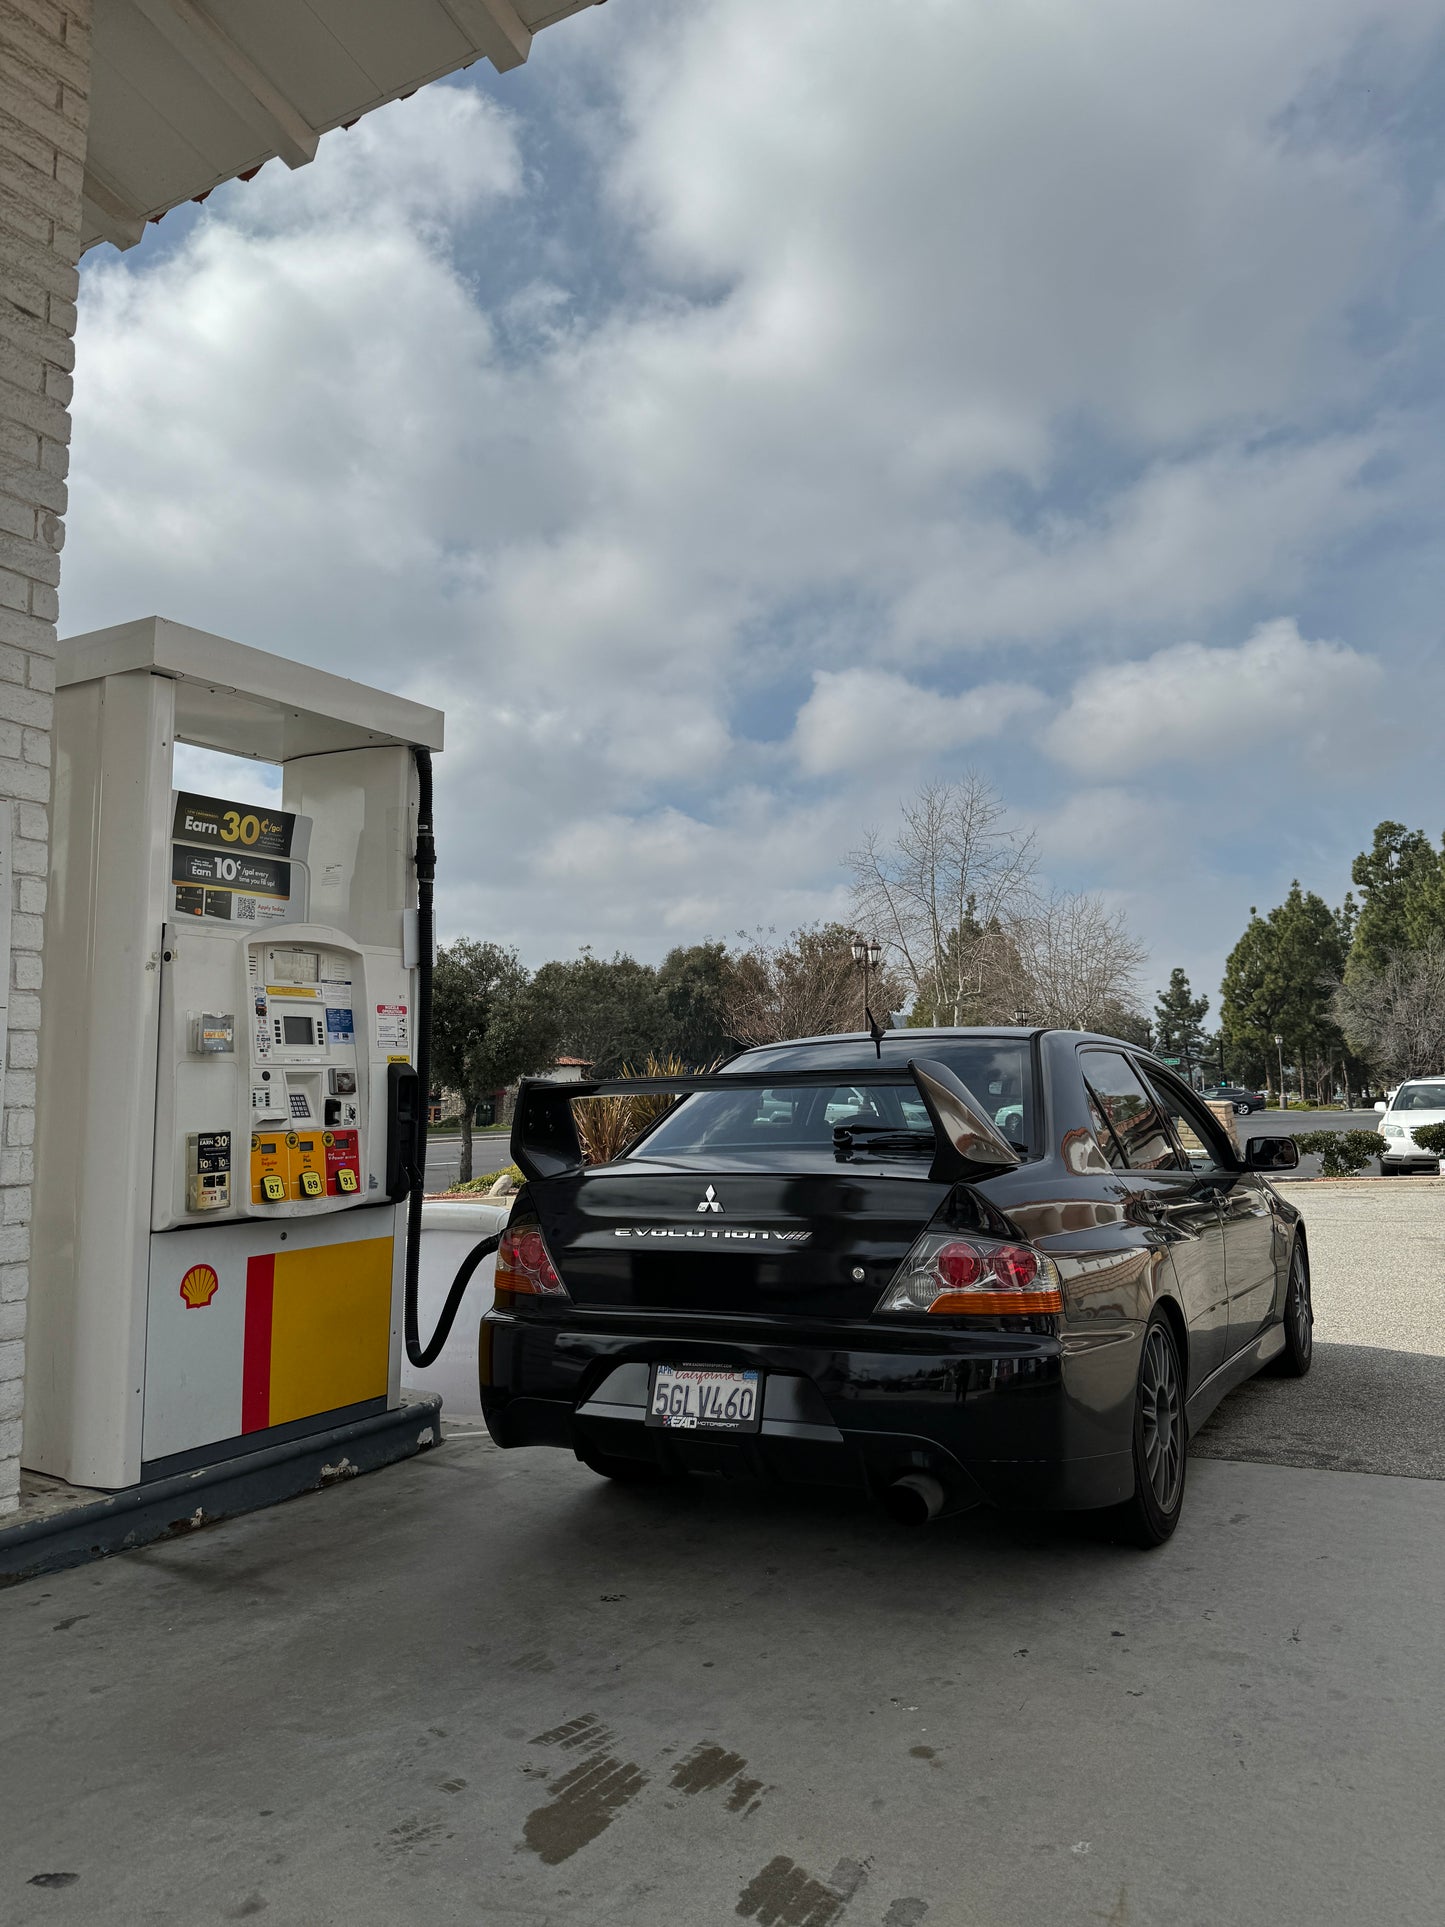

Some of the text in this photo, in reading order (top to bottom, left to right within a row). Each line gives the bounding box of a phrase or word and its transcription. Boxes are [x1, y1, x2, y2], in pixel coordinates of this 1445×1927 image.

[184, 816, 218, 835] Earn
[192, 866, 212, 877] Earn
[307, 1180, 318, 1189] 89
[343, 1177, 353, 1186] 91
[269, 1184, 279, 1193] 87
[615, 1228, 770, 1240] EVOLUTION
